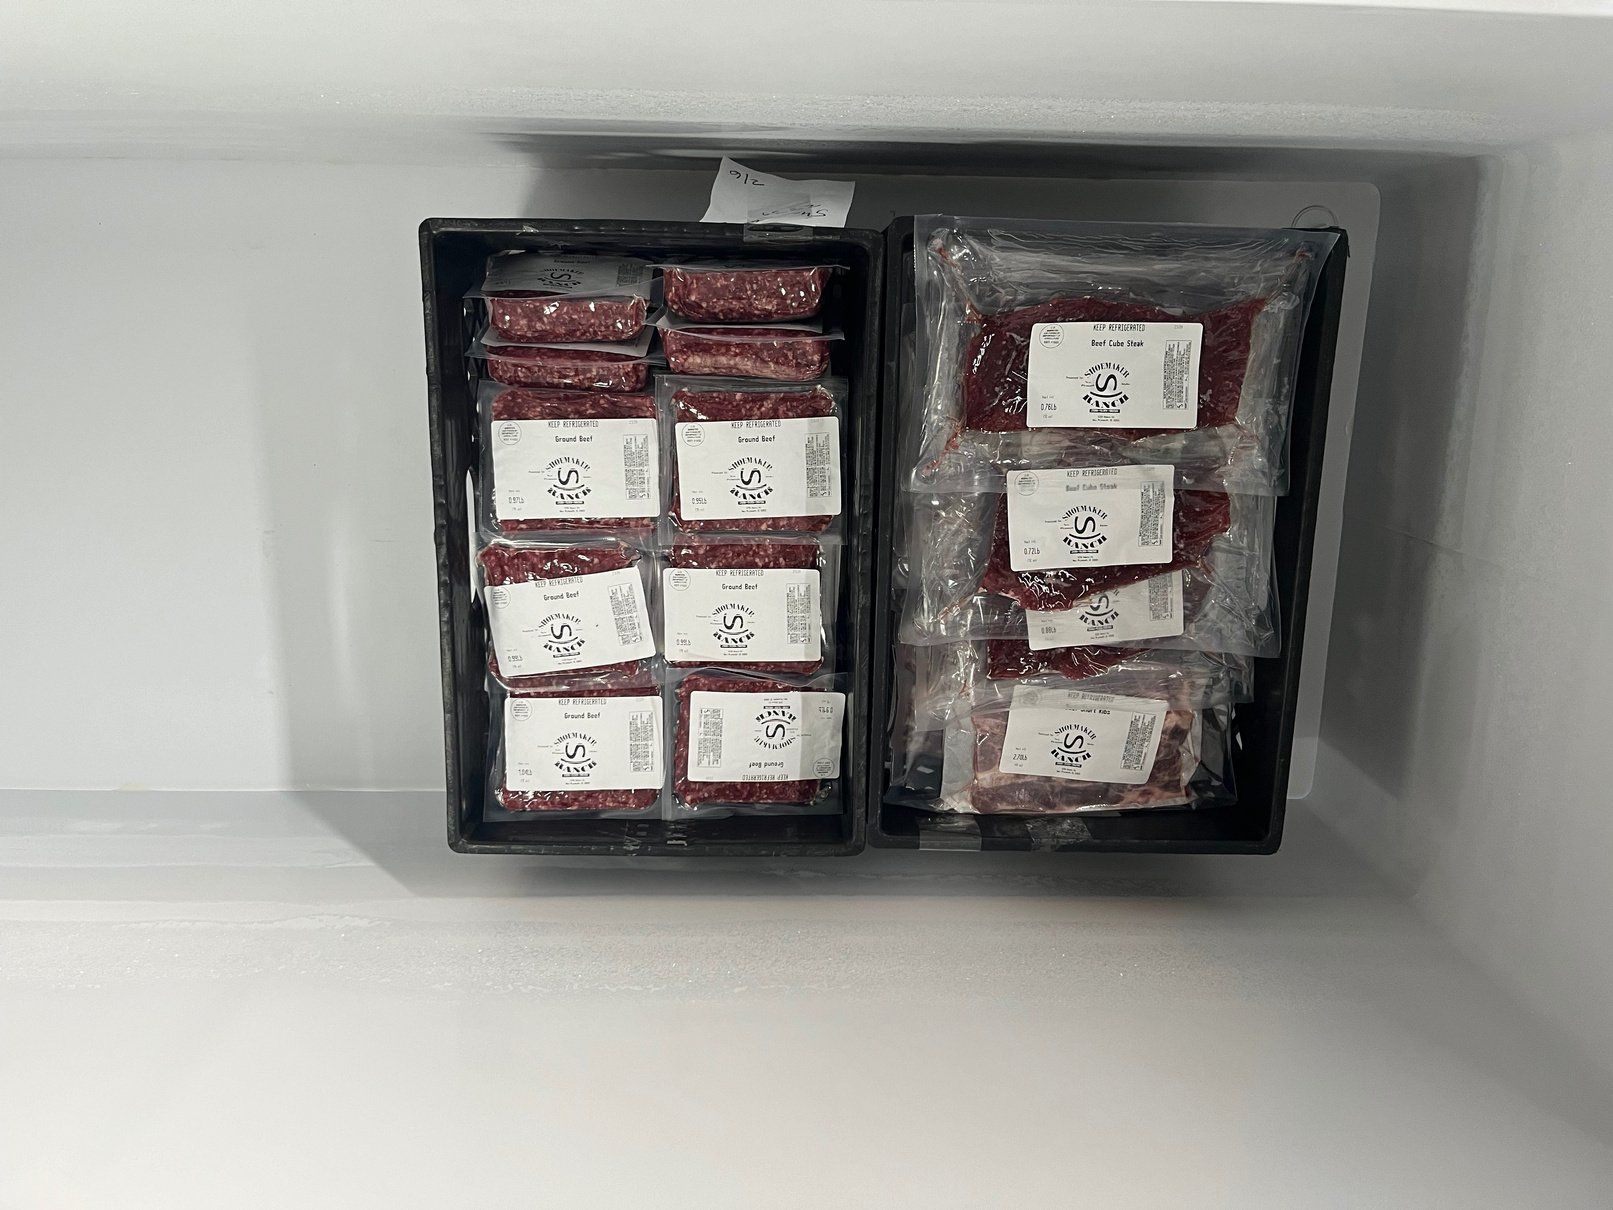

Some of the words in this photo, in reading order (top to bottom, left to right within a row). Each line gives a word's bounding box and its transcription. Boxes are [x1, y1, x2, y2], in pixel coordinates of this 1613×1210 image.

[1093, 324, 1106, 332] KEEP
[1108, 324, 1146, 332] REFRIGERATED
[1091, 339, 1106, 347] Beef
[1108, 339, 1124, 347] Cube
[1127, 339, 1144, 347] Steak
[1082, 394, 1130, 409] RANCH
[562, 420, 600, 428] REFRIGERATED
[731, 421, 743, 429] KEEP
[746, 420, 781, 428] REFRIGERATED
[555, 435, 577, 443] Ground
[1066, 470, 1080, 478] KEEP
[1081, 468, 1118, 477] REFRIGERATED
[547, 486, 592, 500] RANCH
[729, 486, 774, 500] RANCH
[1062, 535, 1108, 550] RANCH
[730, 569, 764, 577] REFRIGERATED
[549, 576, 583, 587] REFRIGERATED
[543, 593, 564, 601] Ground
[565, 590, 579, 598] Beef
[712, 631, 755, 644] RANCH
[543, 638, 586, 653] RANCH
[1051, 749, 1091, 763] RANCH
[554, 760, 597, 773] RANCH
